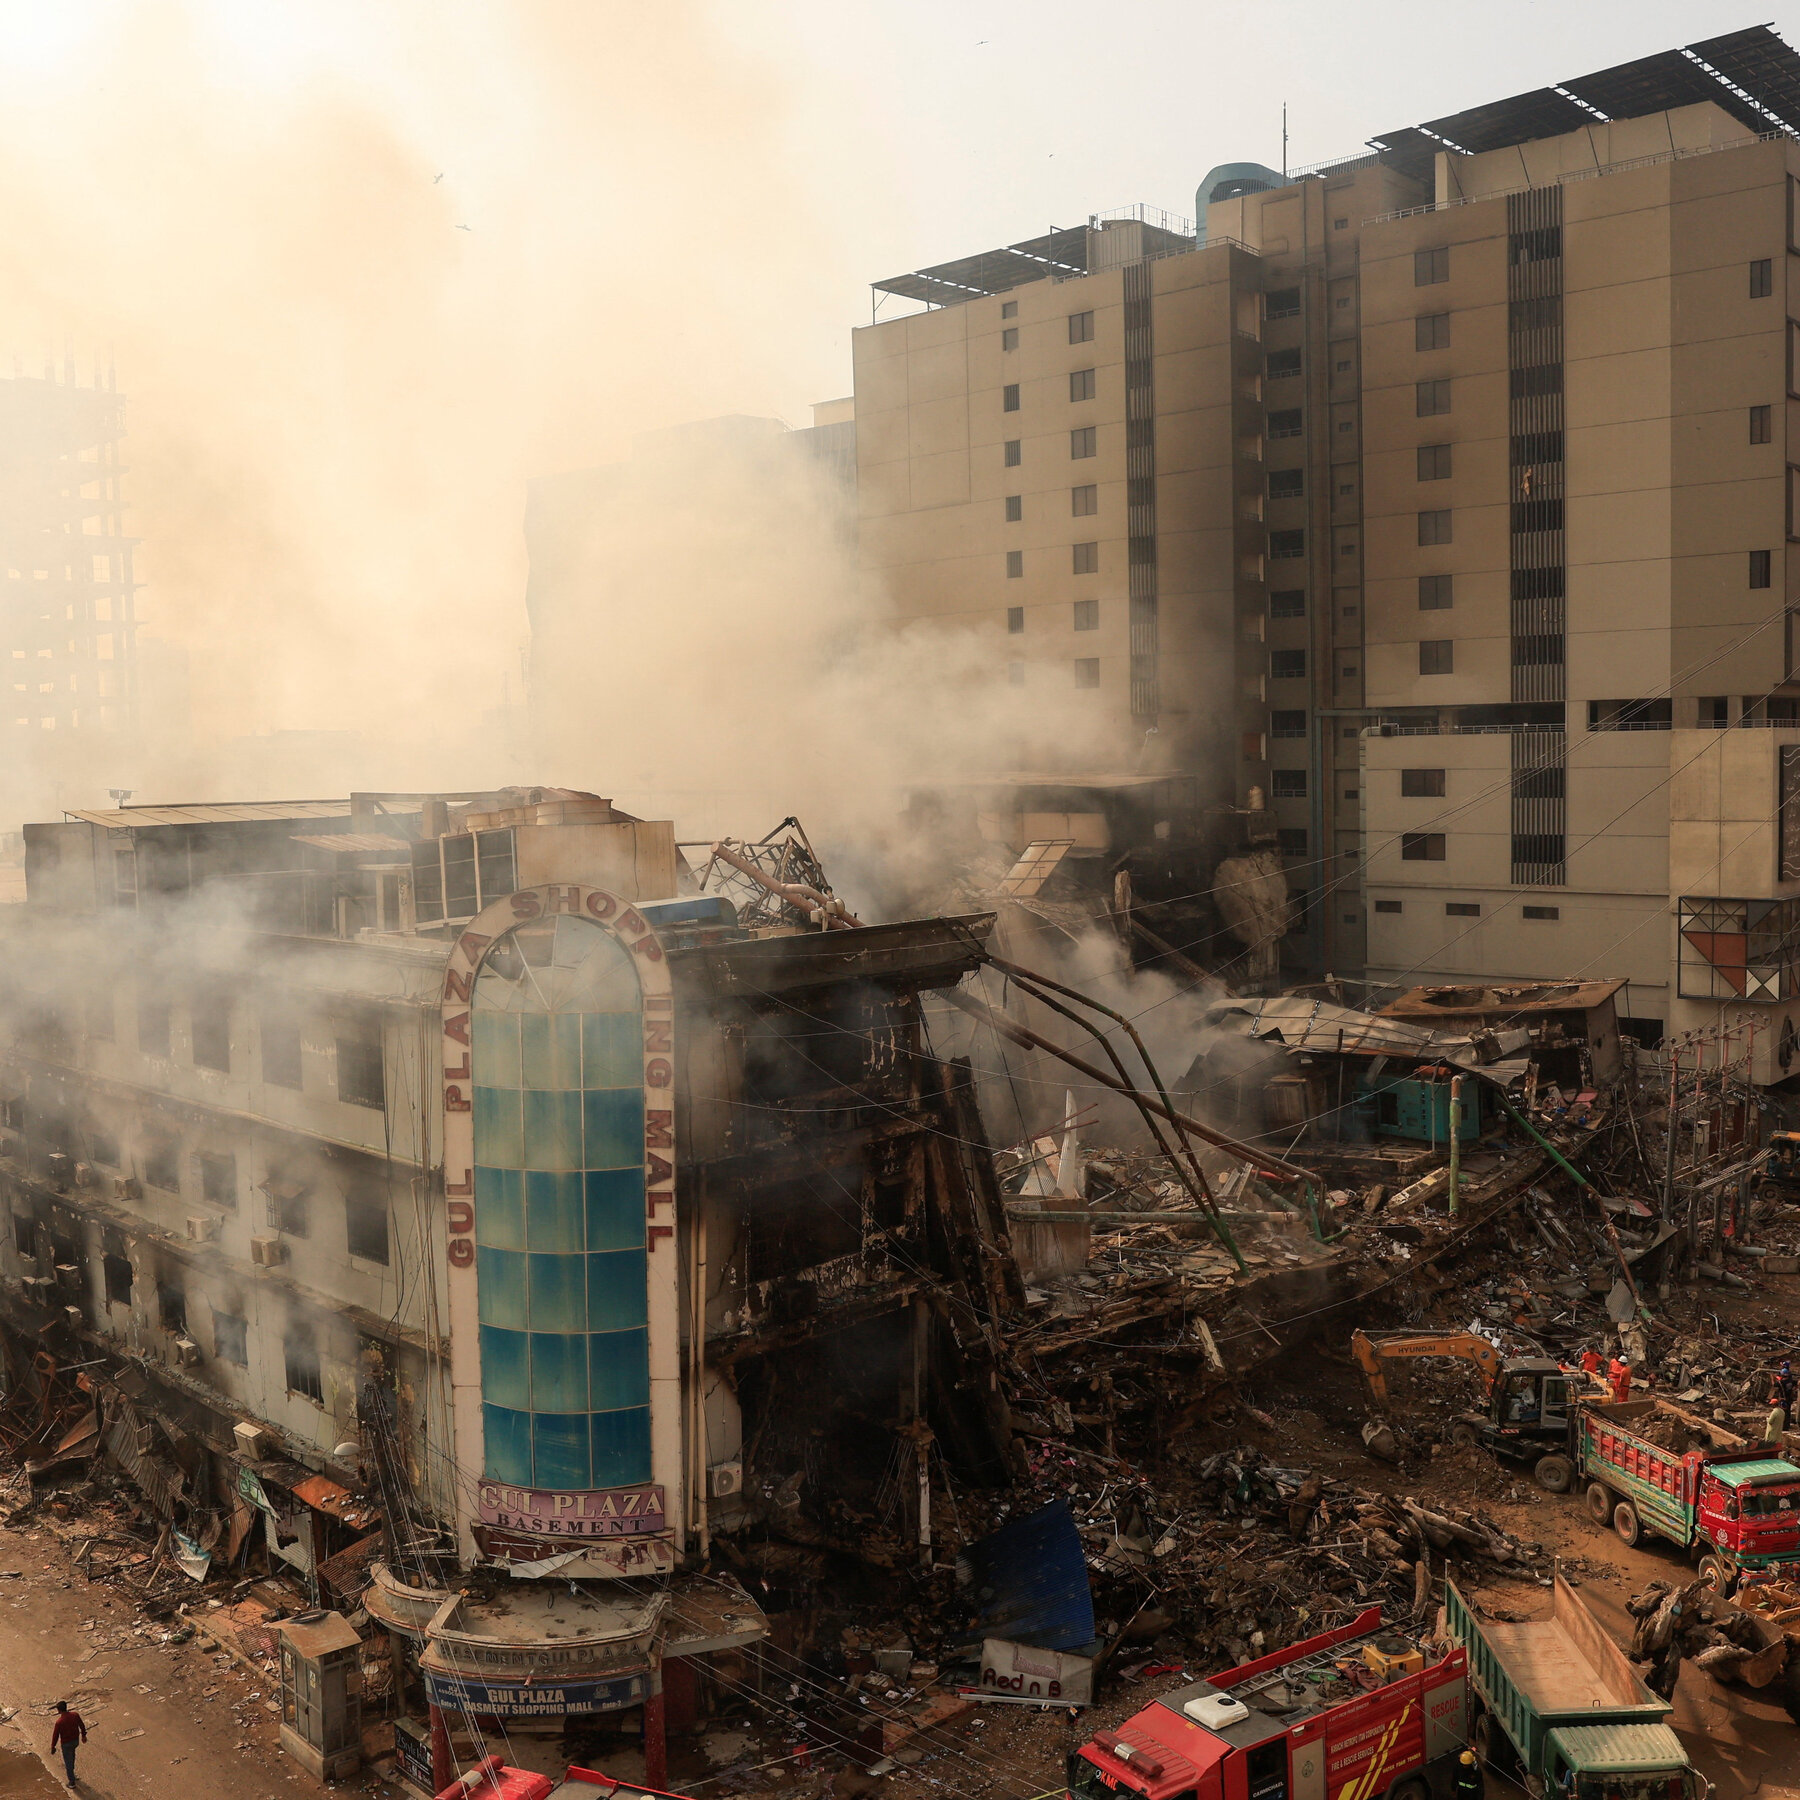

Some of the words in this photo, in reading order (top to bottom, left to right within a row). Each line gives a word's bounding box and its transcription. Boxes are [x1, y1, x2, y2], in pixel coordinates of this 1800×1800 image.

[510, 886, 673, 1089] SHOPPING
[444, 932, 492, 1113] PLAZA
[646, 1110, 673, 1253] MALL
[447, 1168, 475, 1269] GUL
[1398, 1345, 1436, 1354] HYUNDAI
[479, 1485, 541, 1516] GUL
[551, 1491, 665, 1519] PLAZA
[497, 1513, 646, 1534] BASEMENT
[982, 1667, 1024, 1691] Red
[1029, 1681, 1041, 1695] n
[1048, 1680, 1062, 1698] B
[464, 1701, 509, 1714] BASMENT
[511, 1702, 564, 1715] SHOPPING
[566, 1701, 593, 1713] MALL
[488, 1689, 517, 1704] GUL
[518, 1688, 565, 1704] PLAZA
[1430, 1696, 1460, 1720] RESCUE
[1331, 1760, 1340, 1772] FIRE
[1343, 1753, 1358, 1767] RESCUE
[1357, 1746, 1375, 1761] SERVICES
[1100, 1771, 1119, 1791] KMC
[1252, 1781, 1284, 1798] CARMICHAEL
